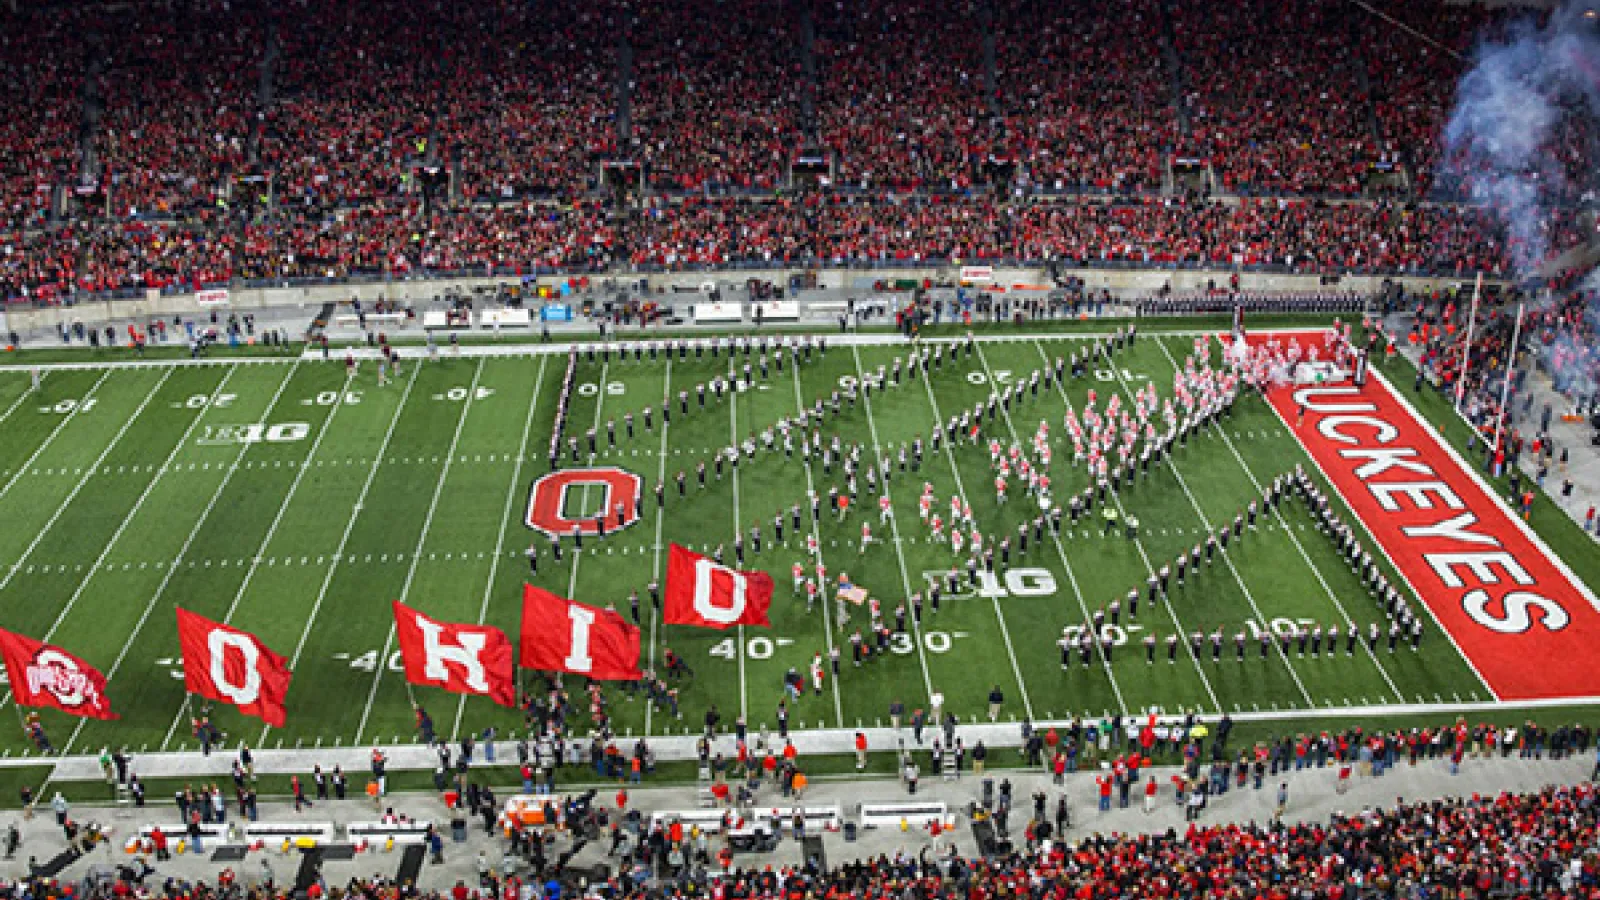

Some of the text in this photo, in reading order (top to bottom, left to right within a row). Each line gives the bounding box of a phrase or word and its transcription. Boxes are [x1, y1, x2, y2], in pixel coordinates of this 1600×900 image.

[1293, 364, 1571, 633] UCKEYES
[693, 558, 748, 623] O
[207, 628, 261, 704] O
[565, 604, 595, 672] I
[710, 638, 774, 659] 40
[890, 631, 951, 654] 30
